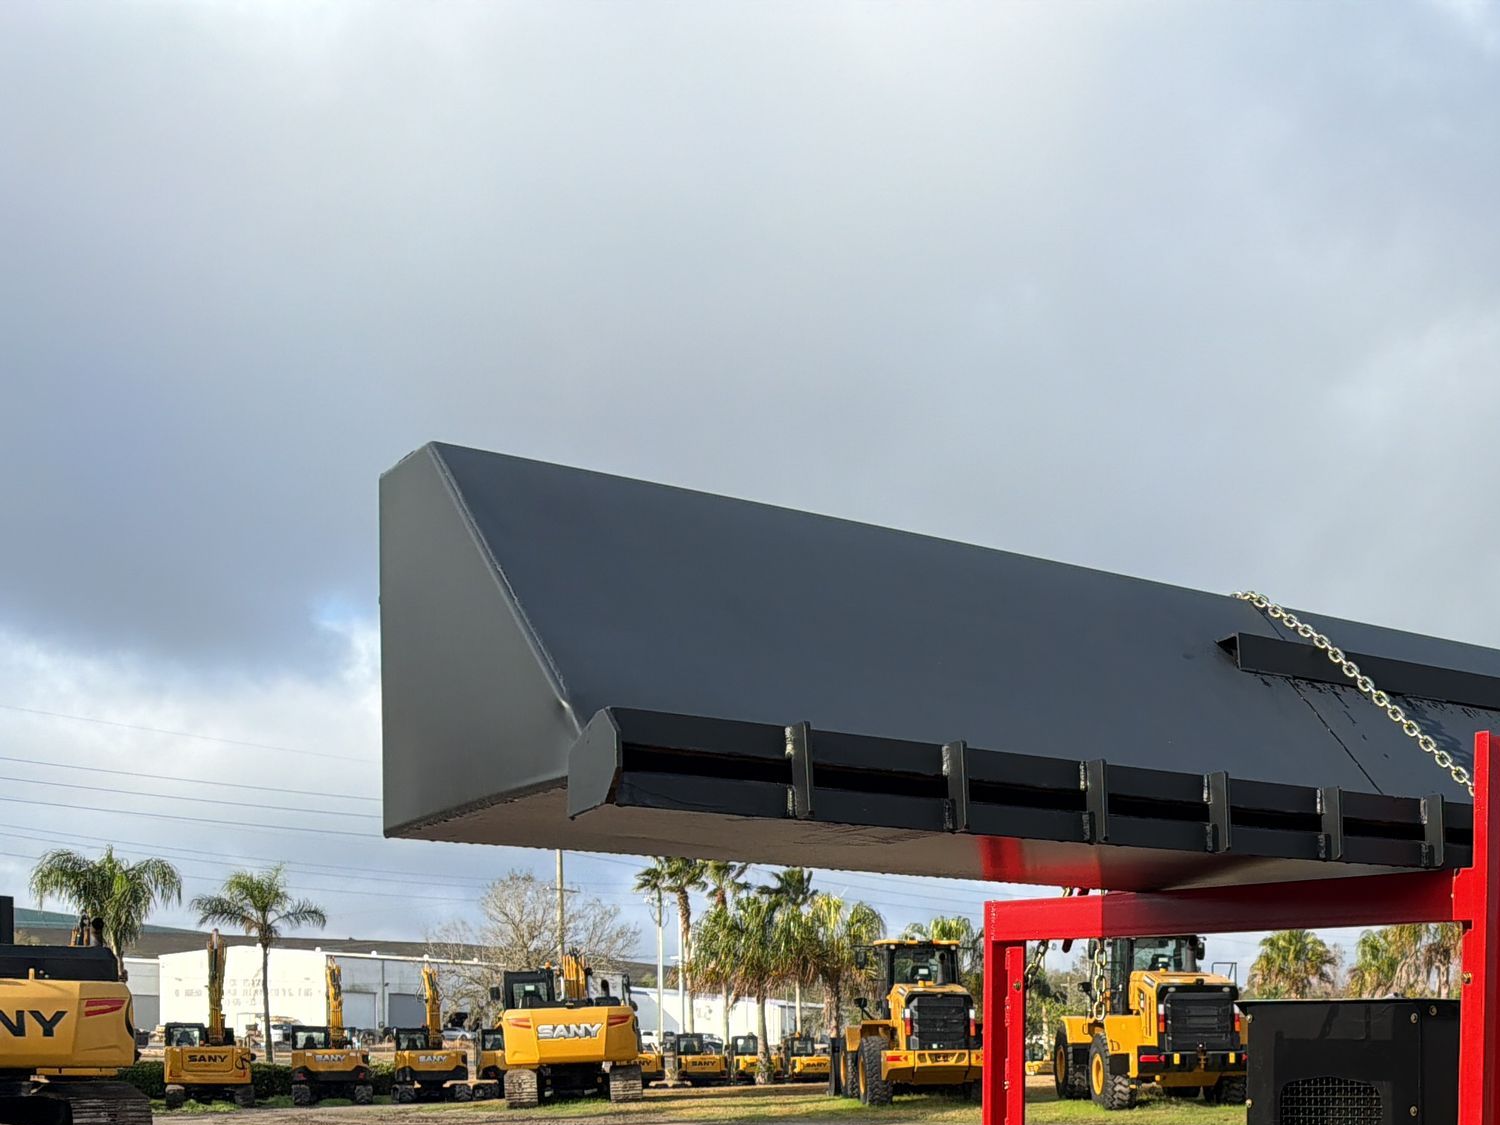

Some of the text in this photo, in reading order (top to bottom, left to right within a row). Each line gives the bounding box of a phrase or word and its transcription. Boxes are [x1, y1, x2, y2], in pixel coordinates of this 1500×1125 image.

[537, 1023, 604, 1040] SANY
[187, 1054, 229, 1063] SANY
[314, 1054, 346, 1063] SANY
[418, 1054, 448, 1063] SANY
